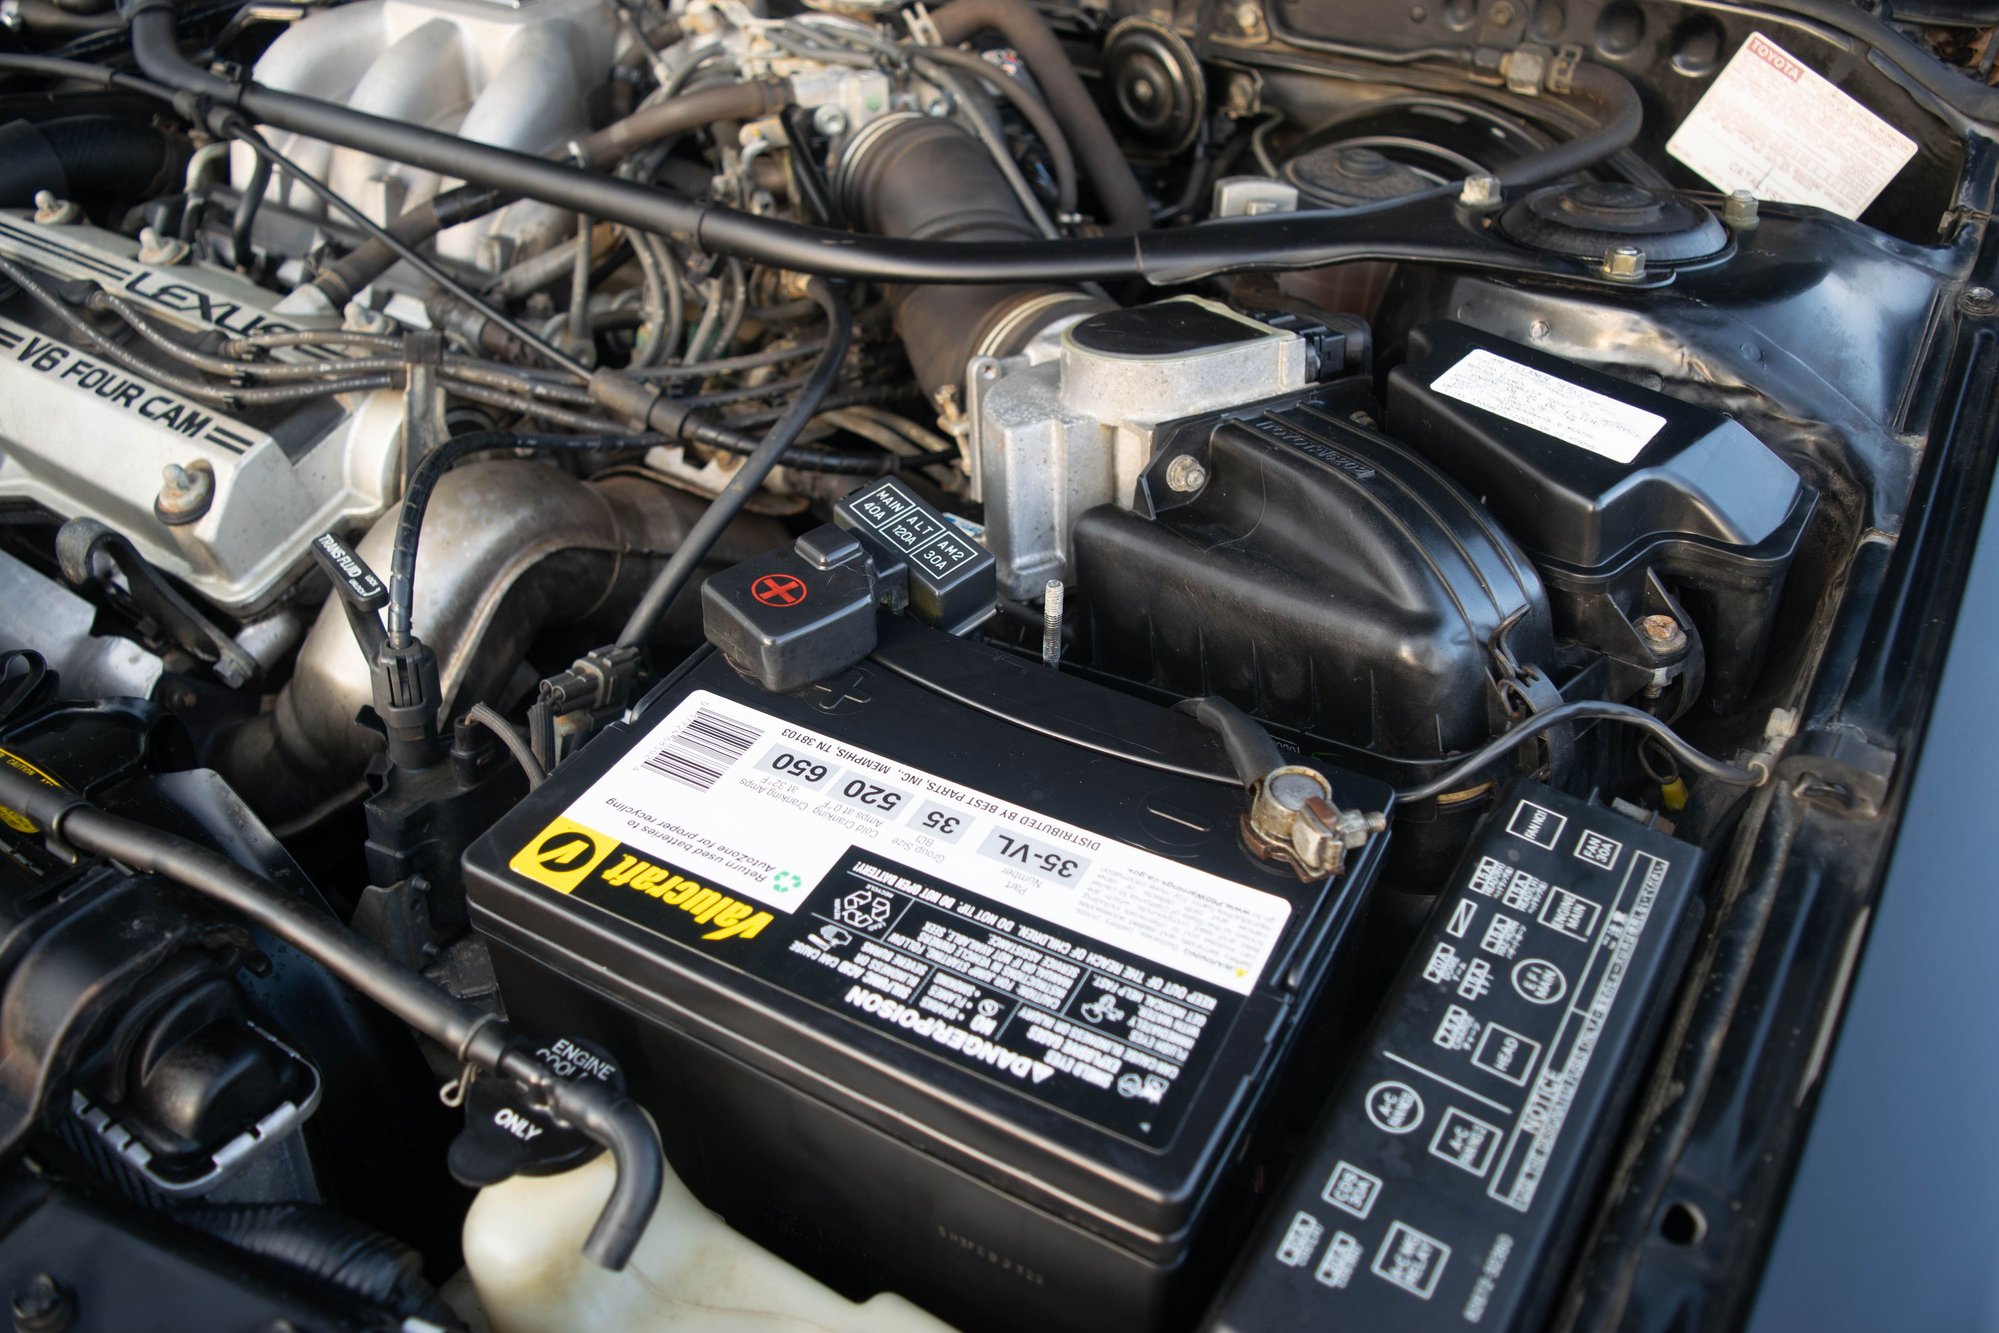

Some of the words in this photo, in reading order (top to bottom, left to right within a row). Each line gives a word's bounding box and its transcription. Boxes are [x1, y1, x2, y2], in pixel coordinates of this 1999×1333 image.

[1750, 40, 1802, 81] TOYOTA
[18, 336, 68, 374] V6
[63, 360, 136, 409] FOUR
[138, 396, 210, 438] CAM
[864, 502, 886, 520] 40A
[875, 490, 905, 513] MAIN
[892, 524, 917, 546] 120A
[906, 515, 933, 535] ALT
[318, 533, 342, 559] TRANS
[337, 554, 362, 578] FLUID
[923, 550, 947, 570] 30A
[937, 540, 965, 561] AM2
[779, 727, 818, 746] 38103
[814, 740, 834, 752] TN
[768, 751, 830, 784] 650
[830, 745, 893, 774] MEMPHIS,
[736, 777, 768, 794] Amps
[892, 768, 925, 785] INC.,
[763, 787, 811, 810] Cranking
[784, 783, 800, 794] at
[839, 777, 904, 812] 520
[921, 779, 967, 801] PARTS,
[603, 796, 660, 823] recycling
[839, 806, 855, 816] at
[964, 795, 999, 813] BEST
[998, 807, 1019, 821] BY
[624, 819, 641, 829] to
[809, 805, 857, 829] Cranking
[852, 810, 885, 828] Amps
[919, 809, 963, 835] 35
[637, 824, 694, 852] batteries
[657, 819, 699, 840] proper
[853, 823, 880, 838] Cold
[913, 833, 935, 847] BCI
[1017, 814, 1102, 851] DISTRIBUTED
[1523, 822, 1541, 839] FAN
[695, 836, 716, 848] for
[888, 836, 914, 851] Size
[1582, 836, 1602, 858] FAN
[1595, 841, 1615, 863] 30A
[690, 846, 725, 865] used
[714, 844, 777, 873] AutoZone
[911, 844, 947, 864] Group
[987, 833, 1080, 879] 35-VL
[721, 859, 769, 883] Return
[850, 859, 899, 885] BATTERY!
[999, 866, 1044, 888] Number
[1473, 862, 1495, 884] 15A
[603, 852, 774, 940] Valucraft
[864, 882, 895, 898] RECYCLE
[892, 876, 924, 895] OPEN
[917, 886, 943, 902] NOT
[1003, 880, 1029, 895] Part
[1508, 877, 1528, 900] 15A
[936, 893, 957, 908] DO
[953, 900, 978, 916] TIP.
[1550, 893, 1577, 929] ENGINE
[971, 907, 1000, 925] NOT
[993, 916, 1016, 932] DO
[1564, 902, 1587, 930] MAIN
[920, 920, 948, 937] SEEK
[1012, 923, 1073, 955] CHILDREN.
[786, 939, 823, 960] CAUSE
[885, 931, 927, 954] FOLLOW
[1067, 944, 1089, 961] OF
[815, 951, 841, 968] CAN
[851, 951, 872, 966] OR
[951, 945, 993, 968] VEHICLE
[990, 947, 1015, 964] NOT
[1038, 954, 1082, 978] SERVICE
[1083, 950, 1125, 975] REACH
[835, 959, 866, 979] ACID
[1018, 959, 1039, 974] OR
[1119, 964, 1148, 984] THE
[991, 974, 1017, 991] FOR
[1142, 973, 1165, 990] OF
[1160, 980, 1189, 1000] OUT
[1533, 967, 1558, 999] MAIN
[1114, 983, 1146, 1003] HELP
[1183, 989, 1218, 1011] KEEP
[840, 983, 1036, 1078] DANGER/POISON
[966, 1012, 999, 1036] NO
[551, 1038, 615, 1080] ENGINE
[1491, 1034, 1521, 1072] HEAD
[1153, 1059, 1181, 1079] CAN
[1518, 1065, 1564, 1136] NOTICE
[494, 1108, 543, 1141] ONLY
